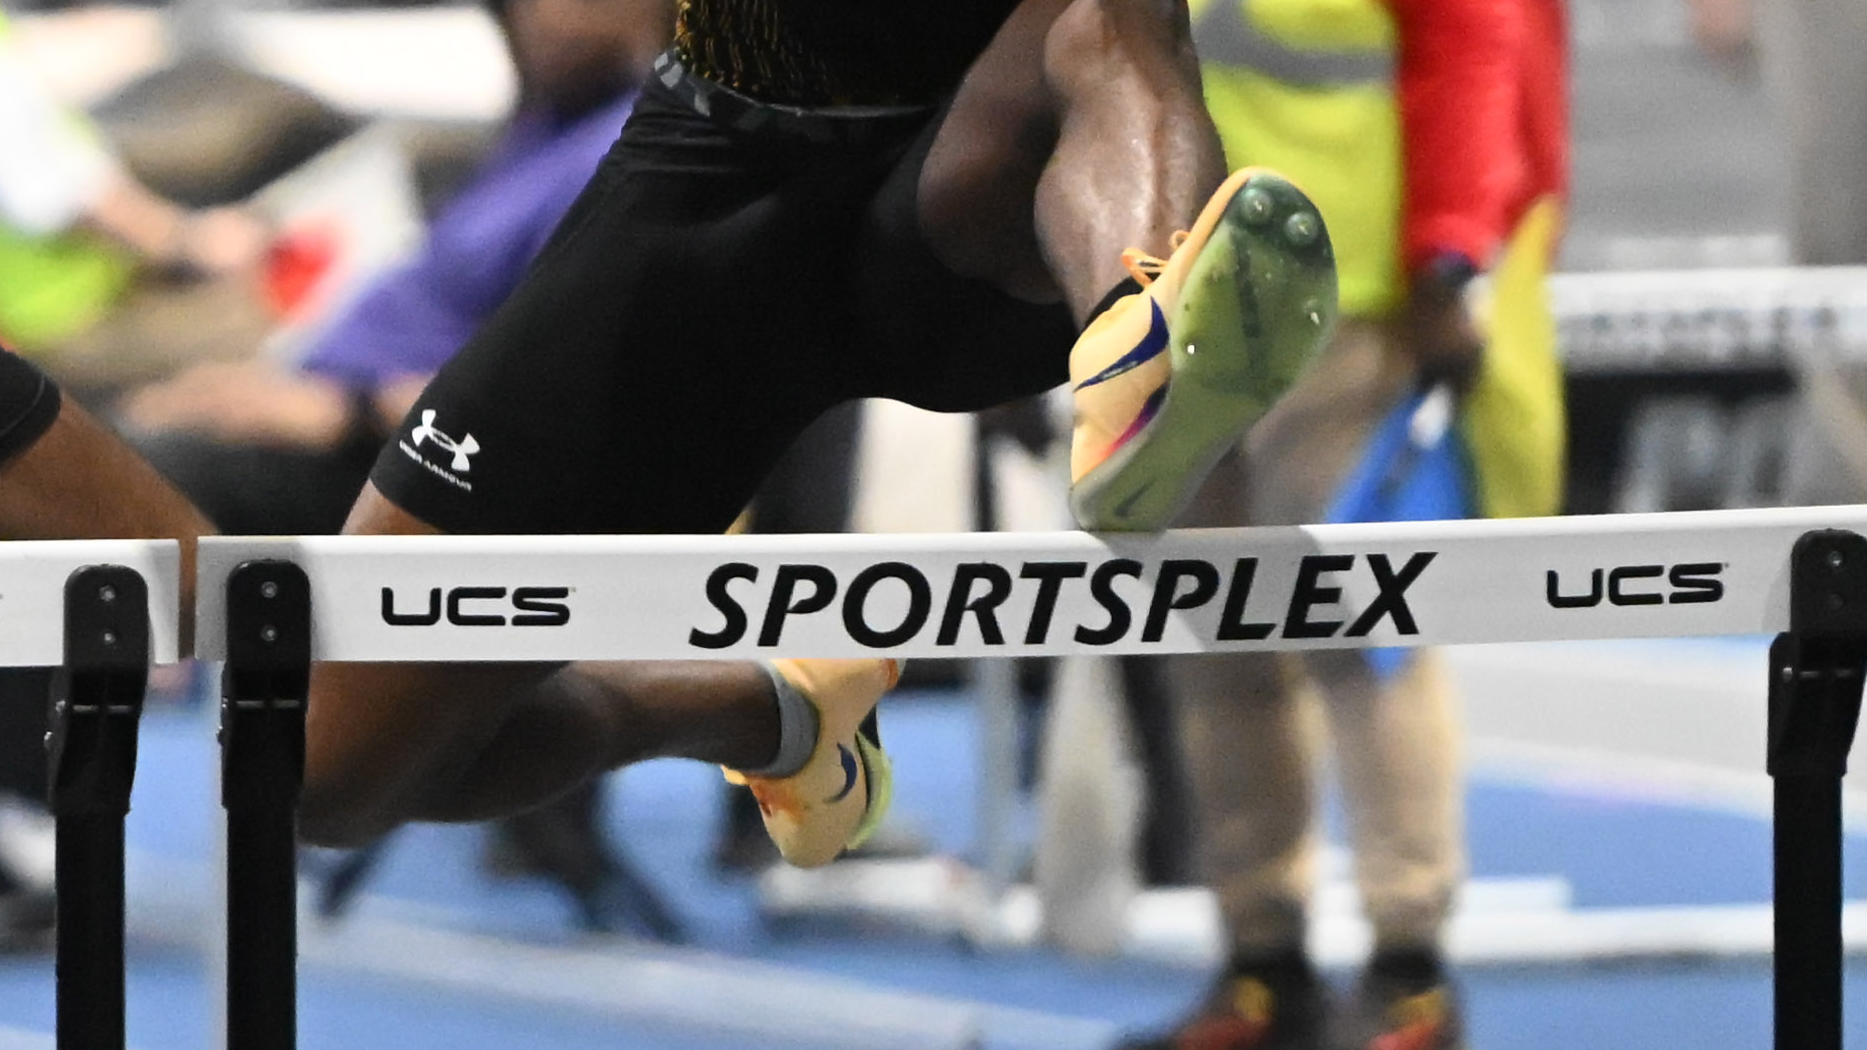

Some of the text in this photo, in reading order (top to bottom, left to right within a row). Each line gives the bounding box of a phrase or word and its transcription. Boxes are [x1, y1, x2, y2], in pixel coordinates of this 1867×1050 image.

[381, 552, 1725, 650] UCS SPORTSPLEX UCS
